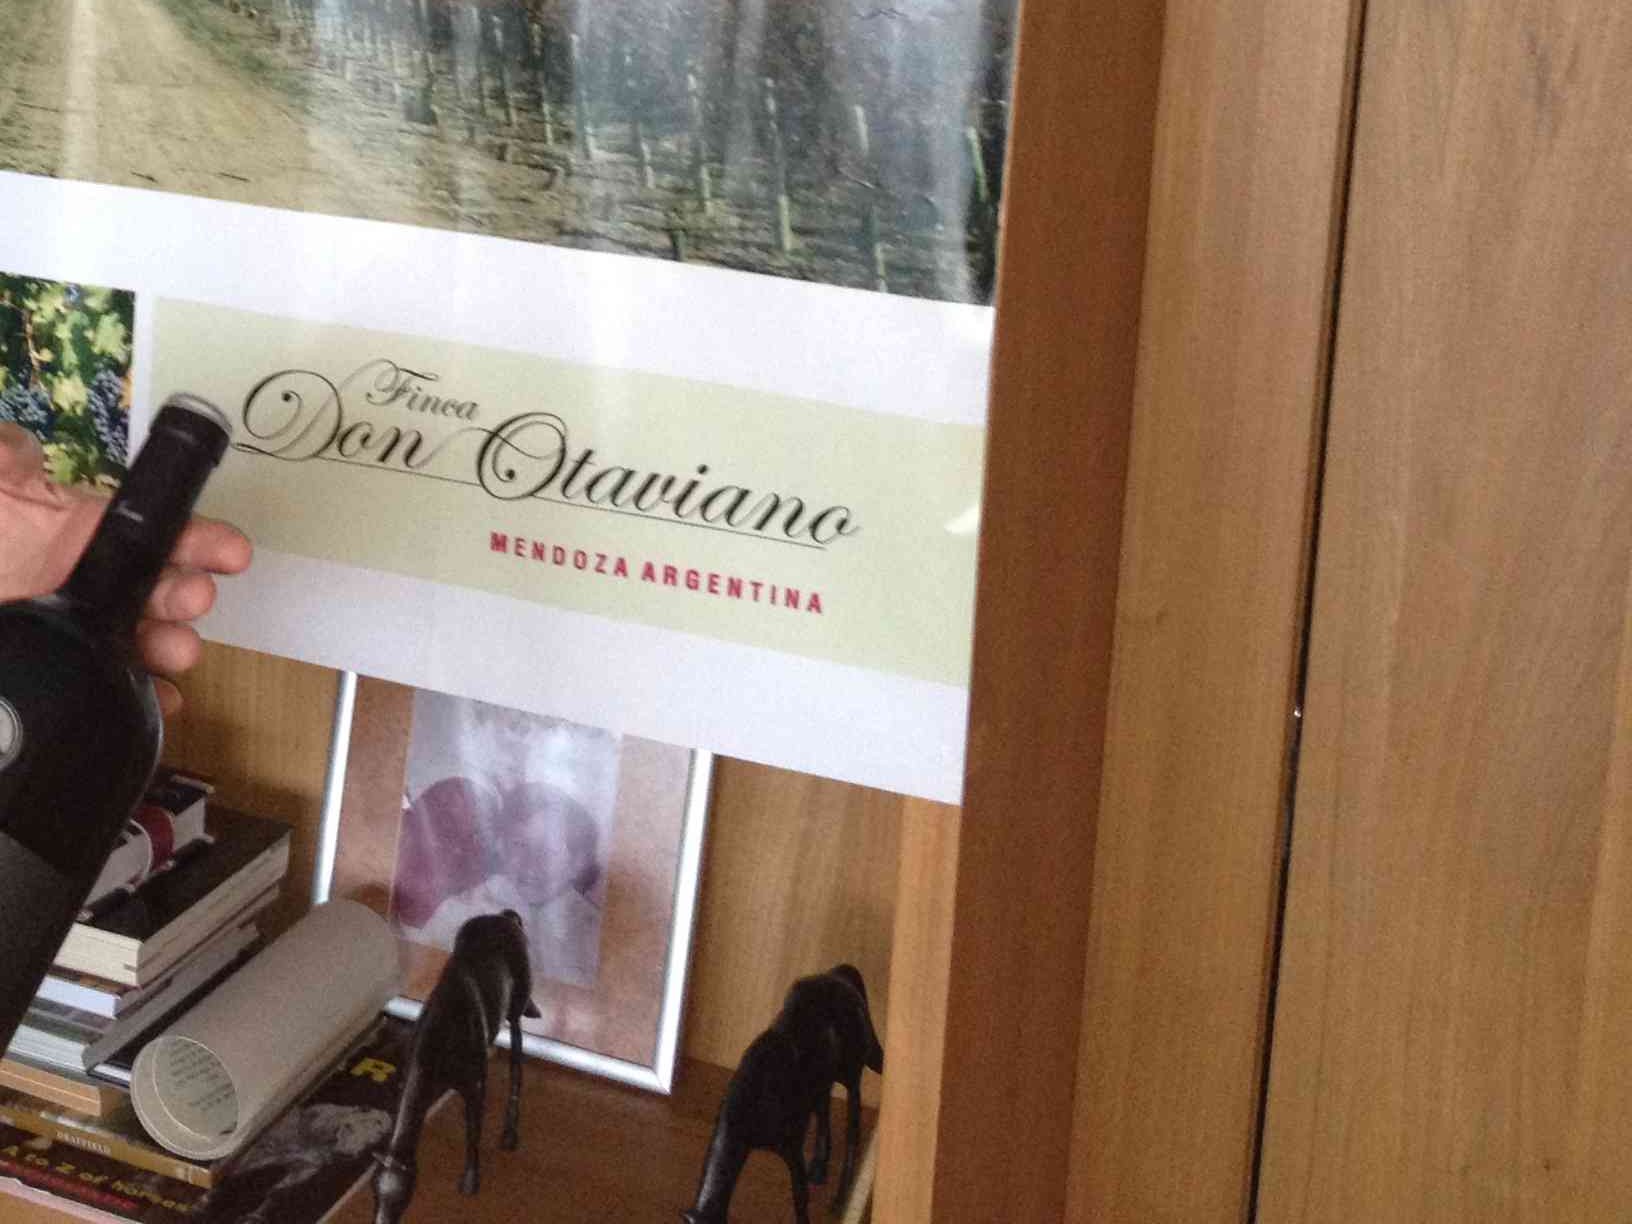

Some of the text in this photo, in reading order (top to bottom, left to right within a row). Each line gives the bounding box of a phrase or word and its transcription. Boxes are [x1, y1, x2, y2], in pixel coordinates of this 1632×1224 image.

[358, 358, 479, 423] Finca
[234, 369, 861, 548] Don Otaviano
[489, 531, 825, 615] MENDOZA ARGENTINA
